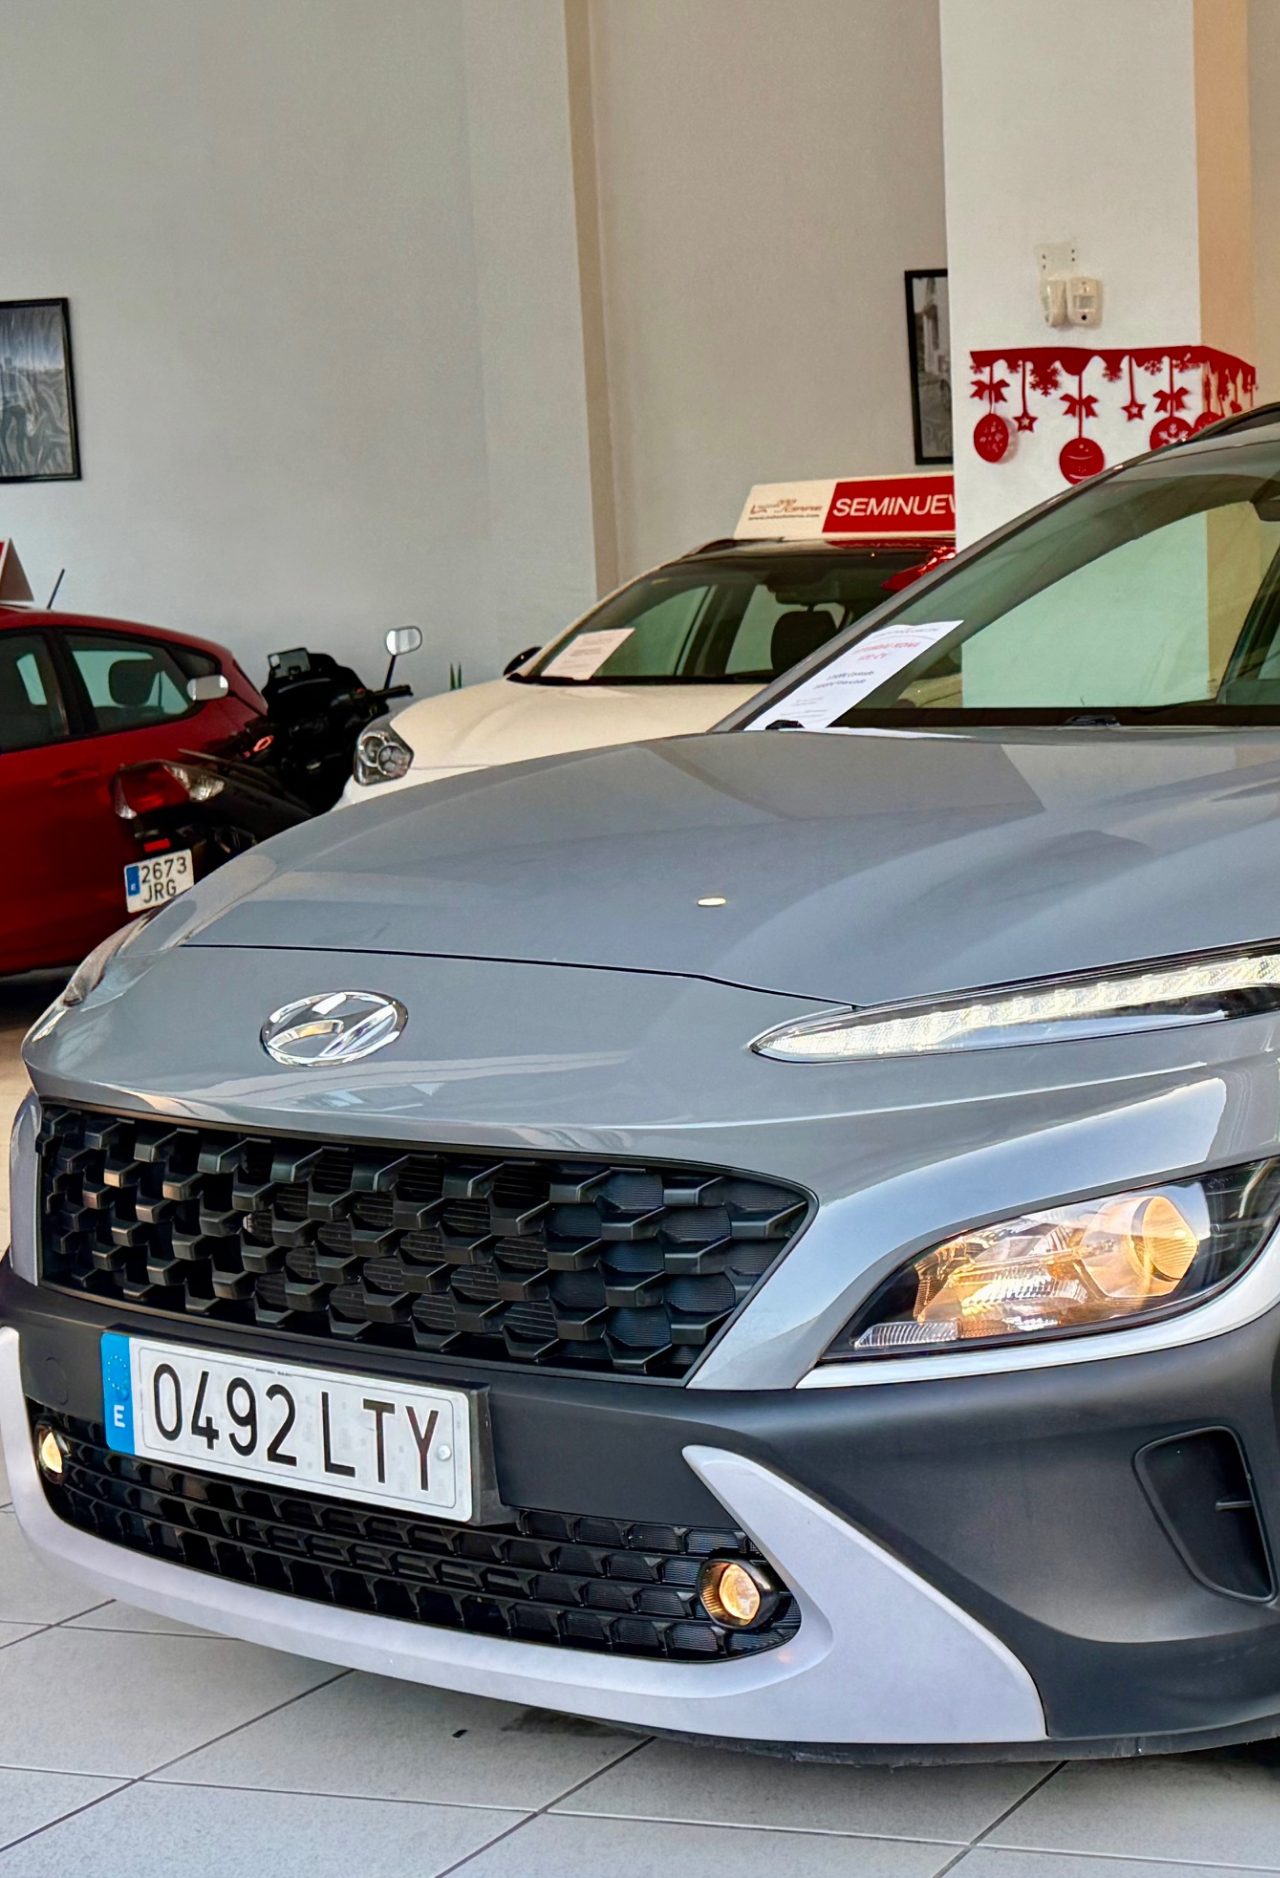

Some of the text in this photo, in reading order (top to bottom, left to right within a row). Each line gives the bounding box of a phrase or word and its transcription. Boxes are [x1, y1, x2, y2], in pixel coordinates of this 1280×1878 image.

[141, 856, 187, 884] 2673
[143, 879, 177, 903] JRG
[114, 1363, 439, 1492] E 0492 LTY
